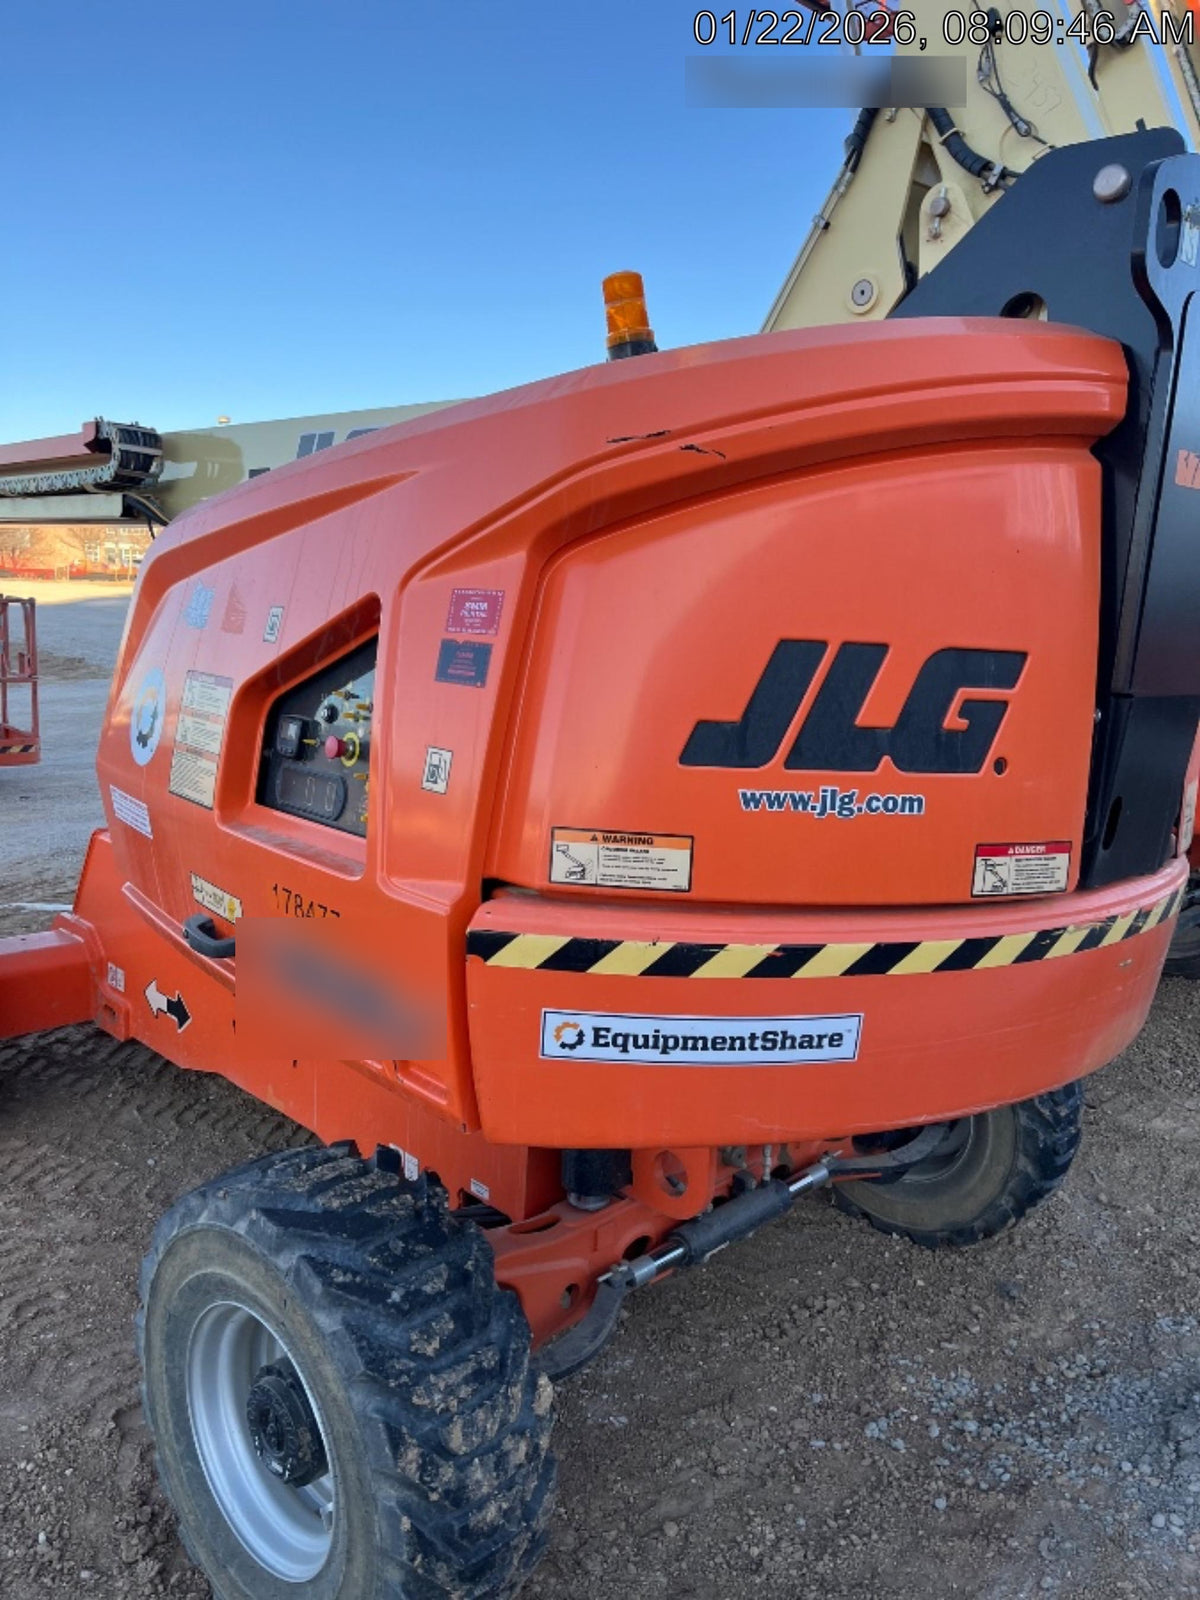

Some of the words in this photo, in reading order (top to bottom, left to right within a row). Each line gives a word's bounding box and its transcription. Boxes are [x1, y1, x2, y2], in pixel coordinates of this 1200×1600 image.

[678, 639, 1030, 776] JLG
[738, 786, 926, 819] www.jlg.com
[591, 1026, 844, 1055] EquipmentShare
